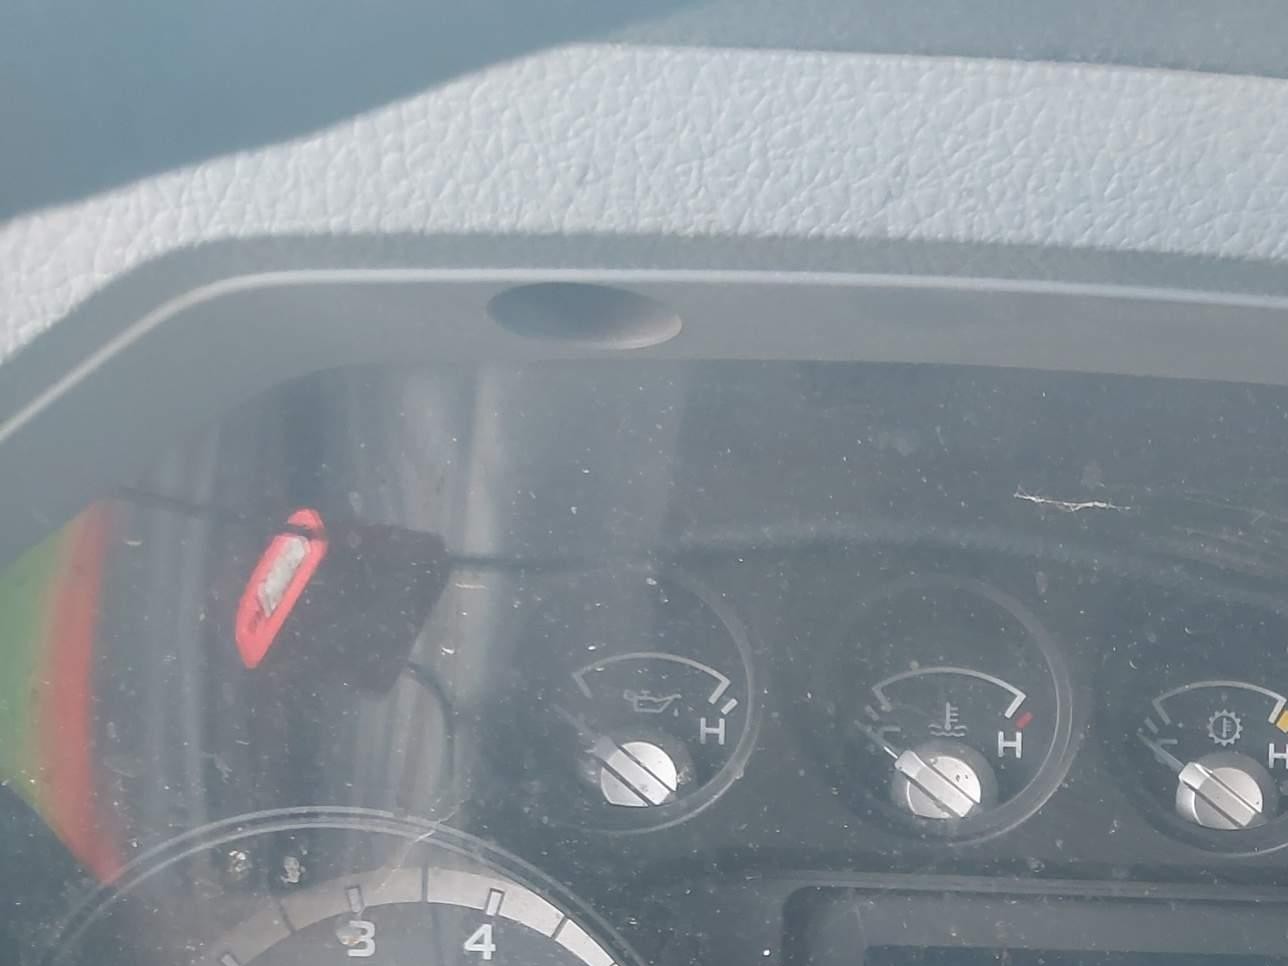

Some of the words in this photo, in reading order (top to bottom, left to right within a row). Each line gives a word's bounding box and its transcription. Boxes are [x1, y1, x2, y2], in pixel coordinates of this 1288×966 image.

[701, 717, 725, 744] H
[998, 731, 1022, 758] H
[347, 921, 376, 957] 3
[464, 924, 496, 960] 4
